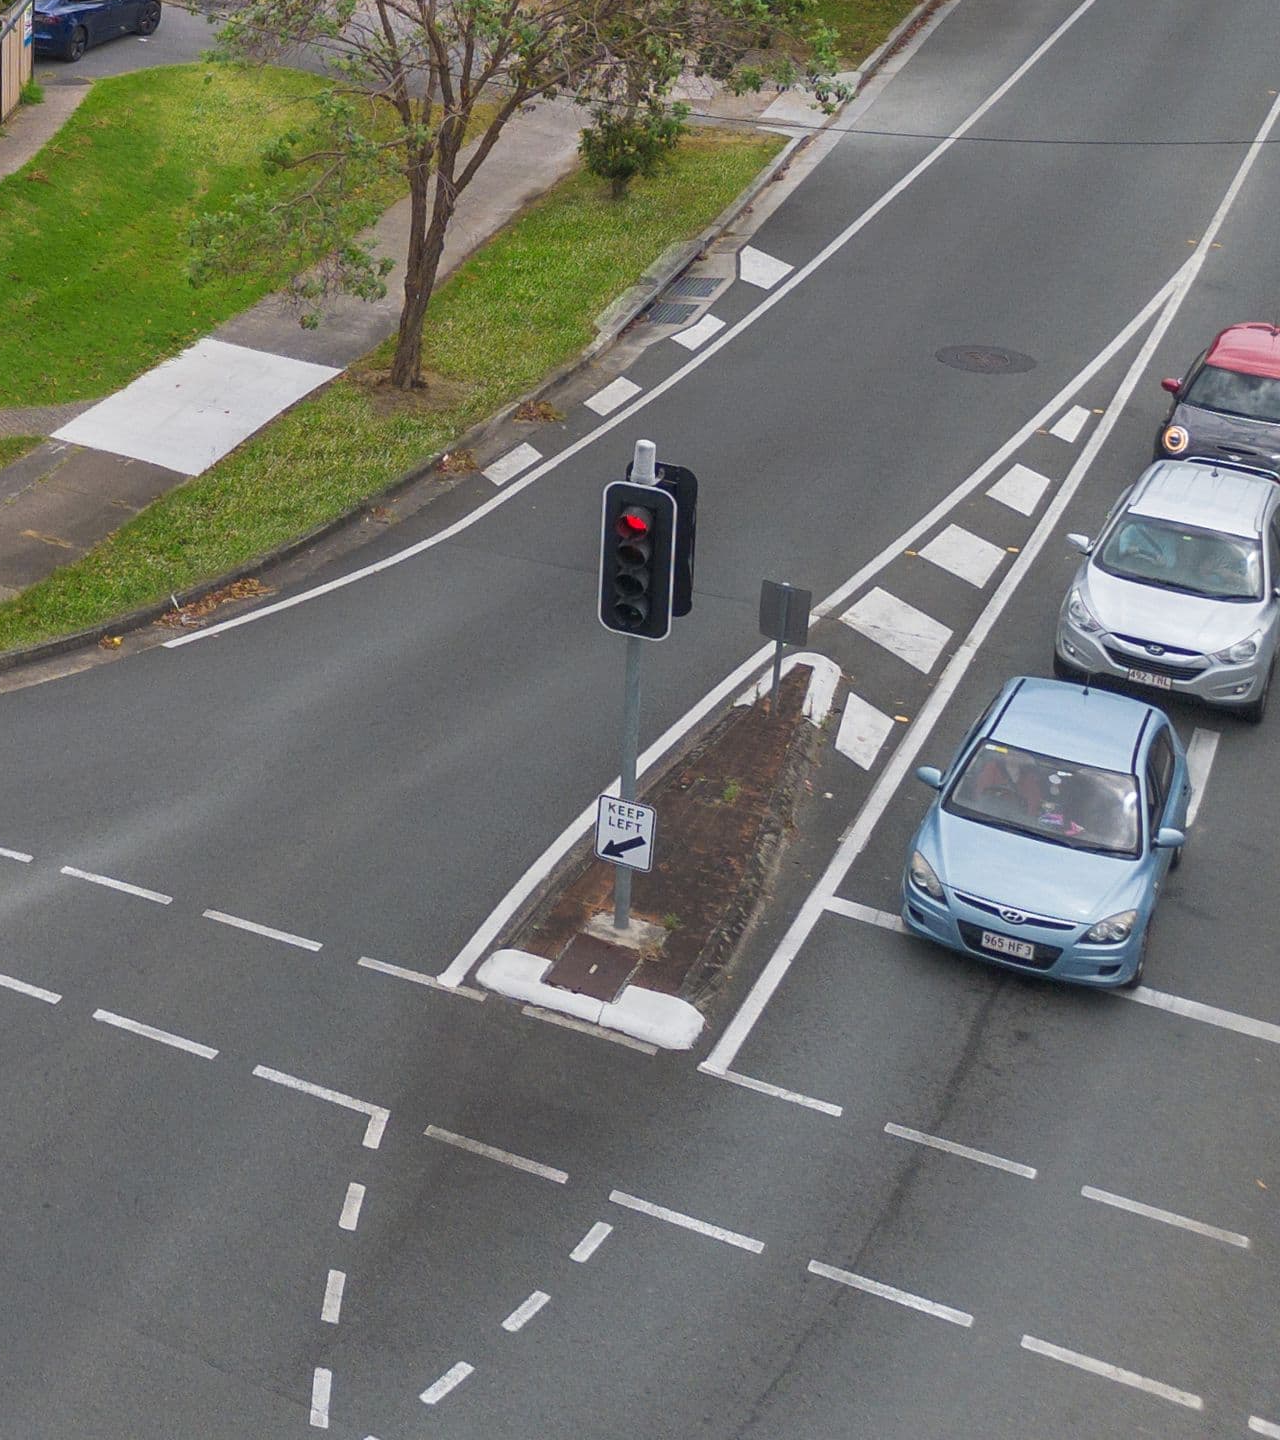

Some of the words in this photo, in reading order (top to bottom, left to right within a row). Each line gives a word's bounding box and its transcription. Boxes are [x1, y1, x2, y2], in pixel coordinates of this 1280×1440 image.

[608, 802, 645, 820] KEEP
[609, 815, 643, 833] LEFT
[984, 934, 1005, 948] 965
